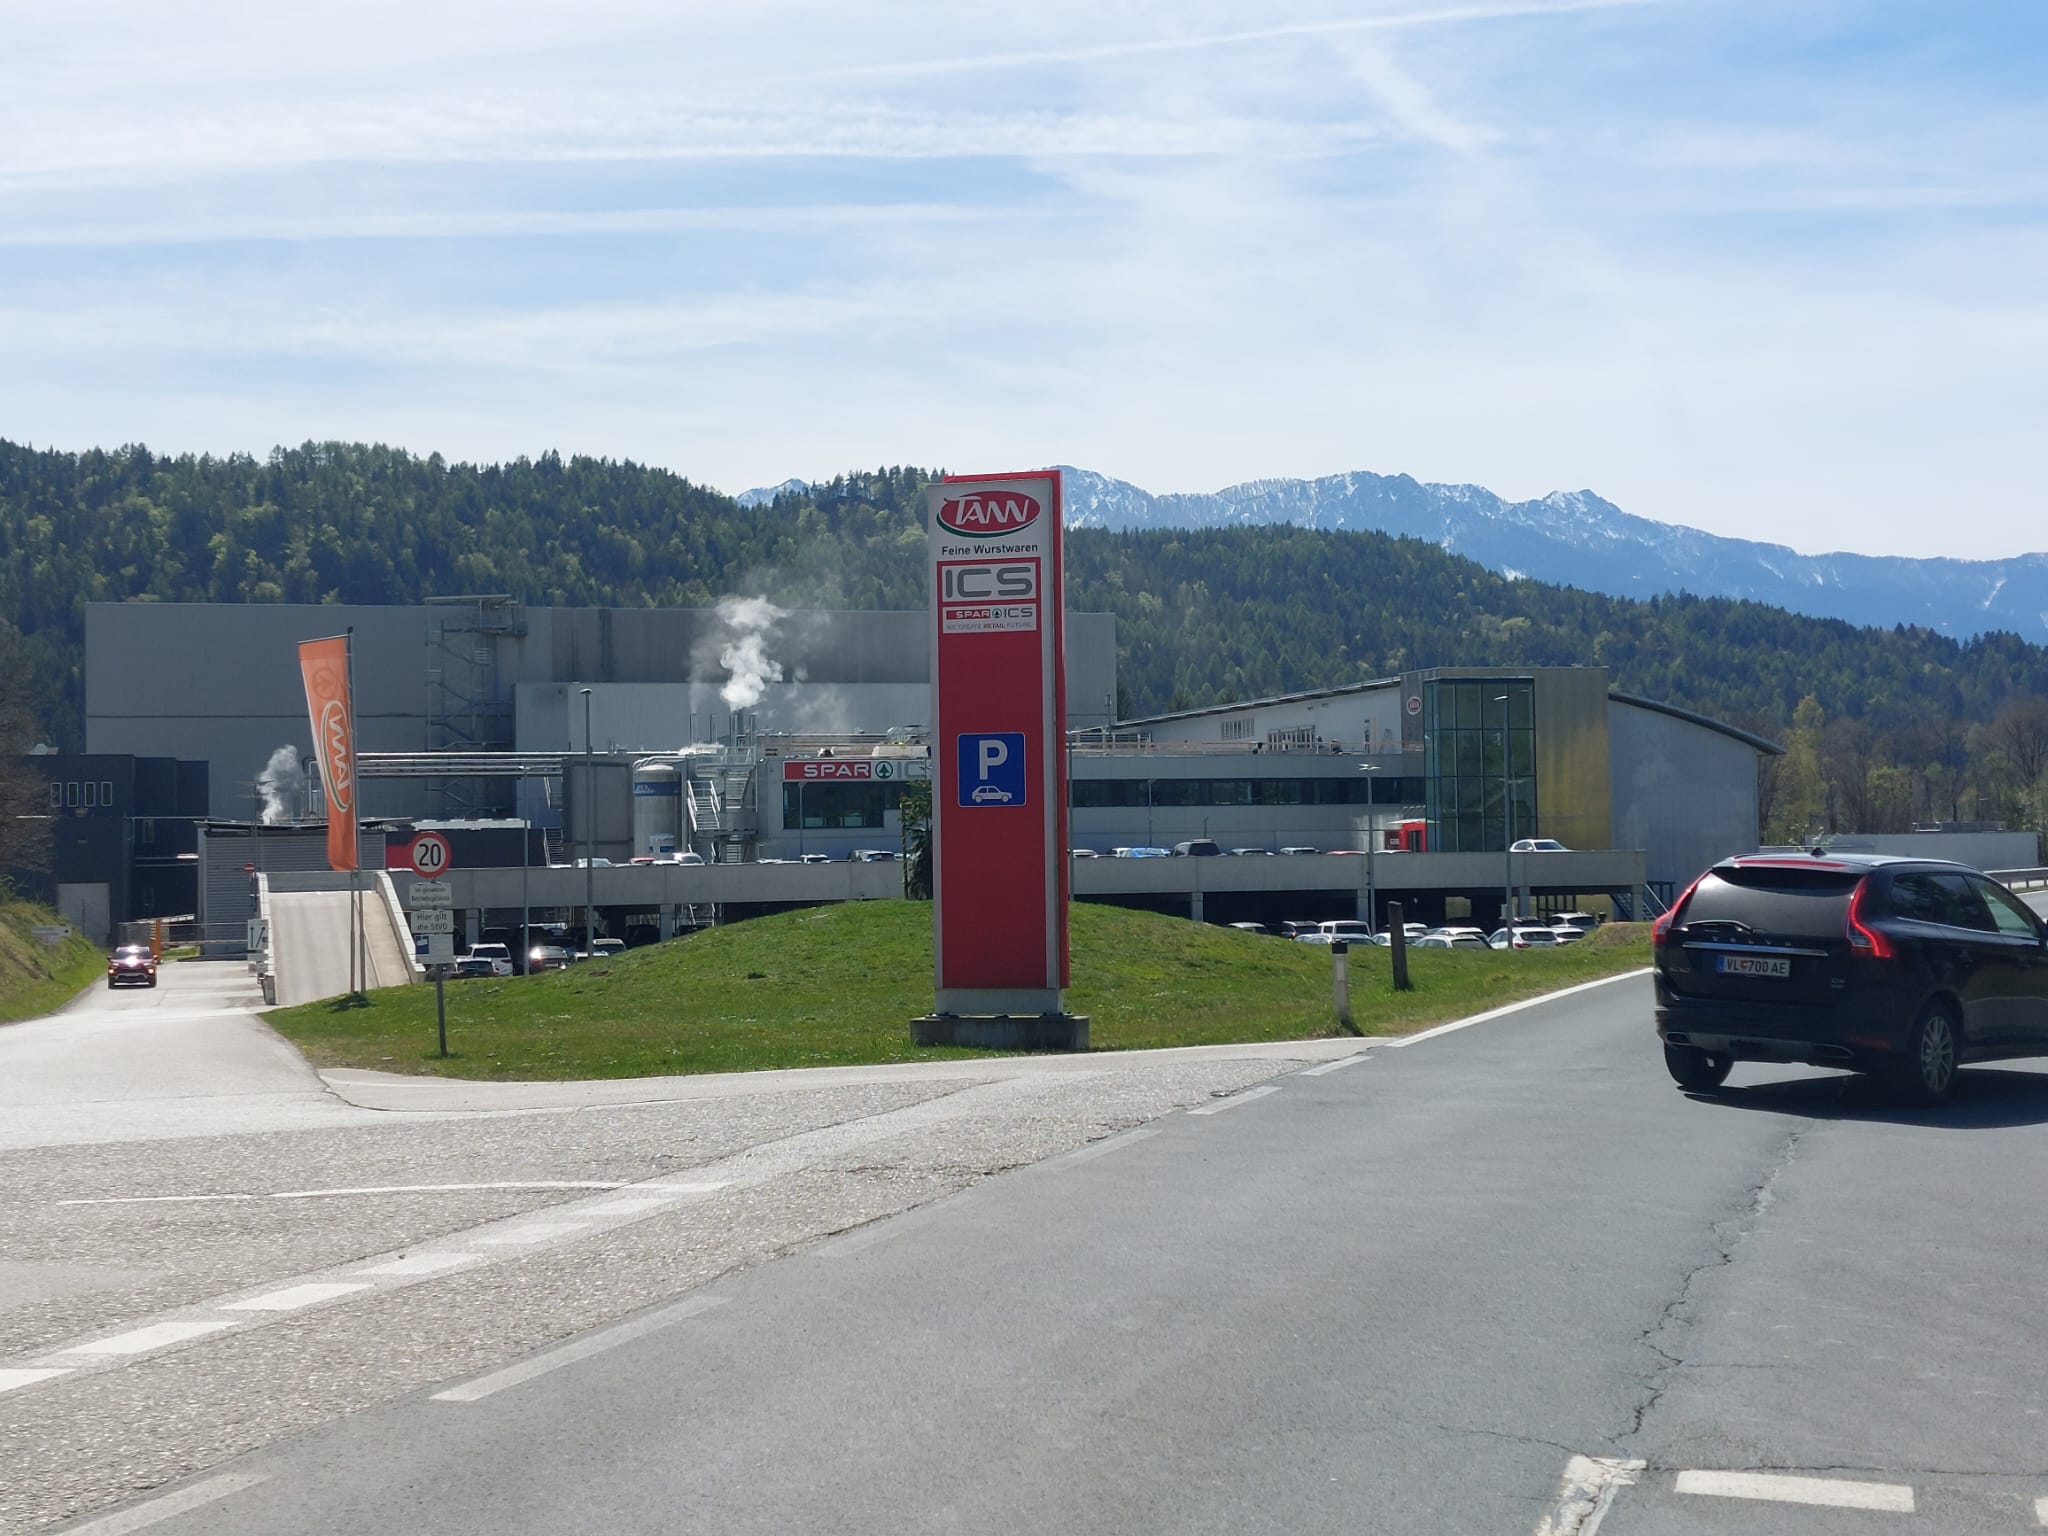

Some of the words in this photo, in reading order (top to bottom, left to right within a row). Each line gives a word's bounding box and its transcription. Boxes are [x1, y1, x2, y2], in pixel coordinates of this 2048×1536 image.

[946, 495, 1029, 525] TANN
[942, 546, 971, 556] Feine
[974, 544, 1038, 554] Wurstwaren
[945, 567, 1032, 598] ICS
[955, 610, 990, 619] SPAR
[1003, 608, 1033, 618] ICS
[979, 740, 1008, 780] P
[804, 764, 869, 777] SPAR
[418, 843, 442, 867] 20
[417, 913, 432, 921] Hier
[434, 912, 448, 922] gilt
[1727, 959, 1739, 970] VL
[1748, 961, 1769, 973] 700
[1771, 962, 1787, 975] AE
